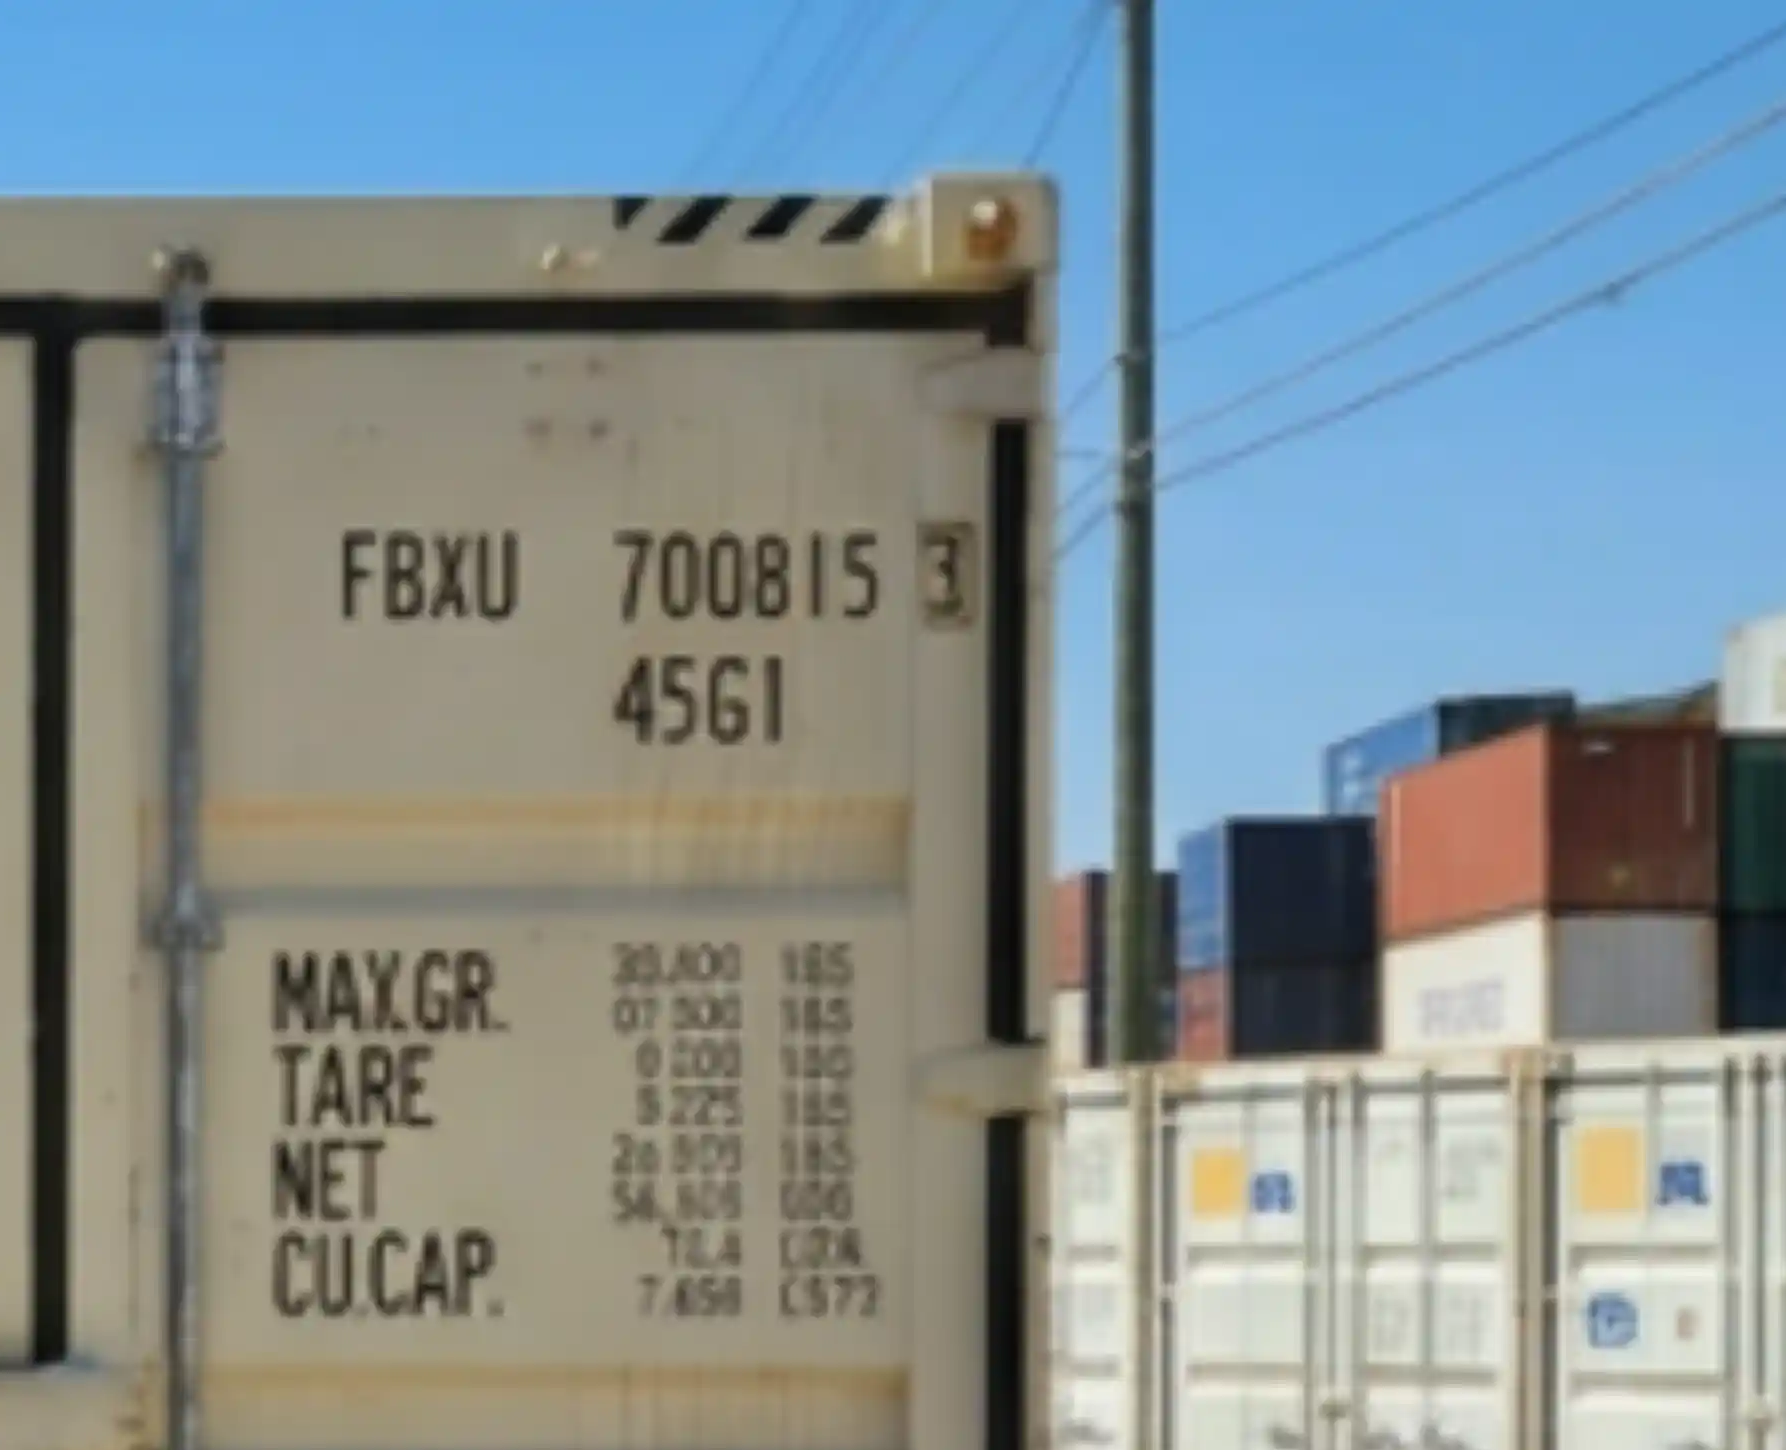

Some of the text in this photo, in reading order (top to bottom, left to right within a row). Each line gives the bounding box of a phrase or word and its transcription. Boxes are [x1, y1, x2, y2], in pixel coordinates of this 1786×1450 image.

[340, 529, 520, 623] FBXU
[613, 529, 881, 623] 700815
[272, 1042, 435, 1128] TARE
[272, 1137, 386, 1222] NET
